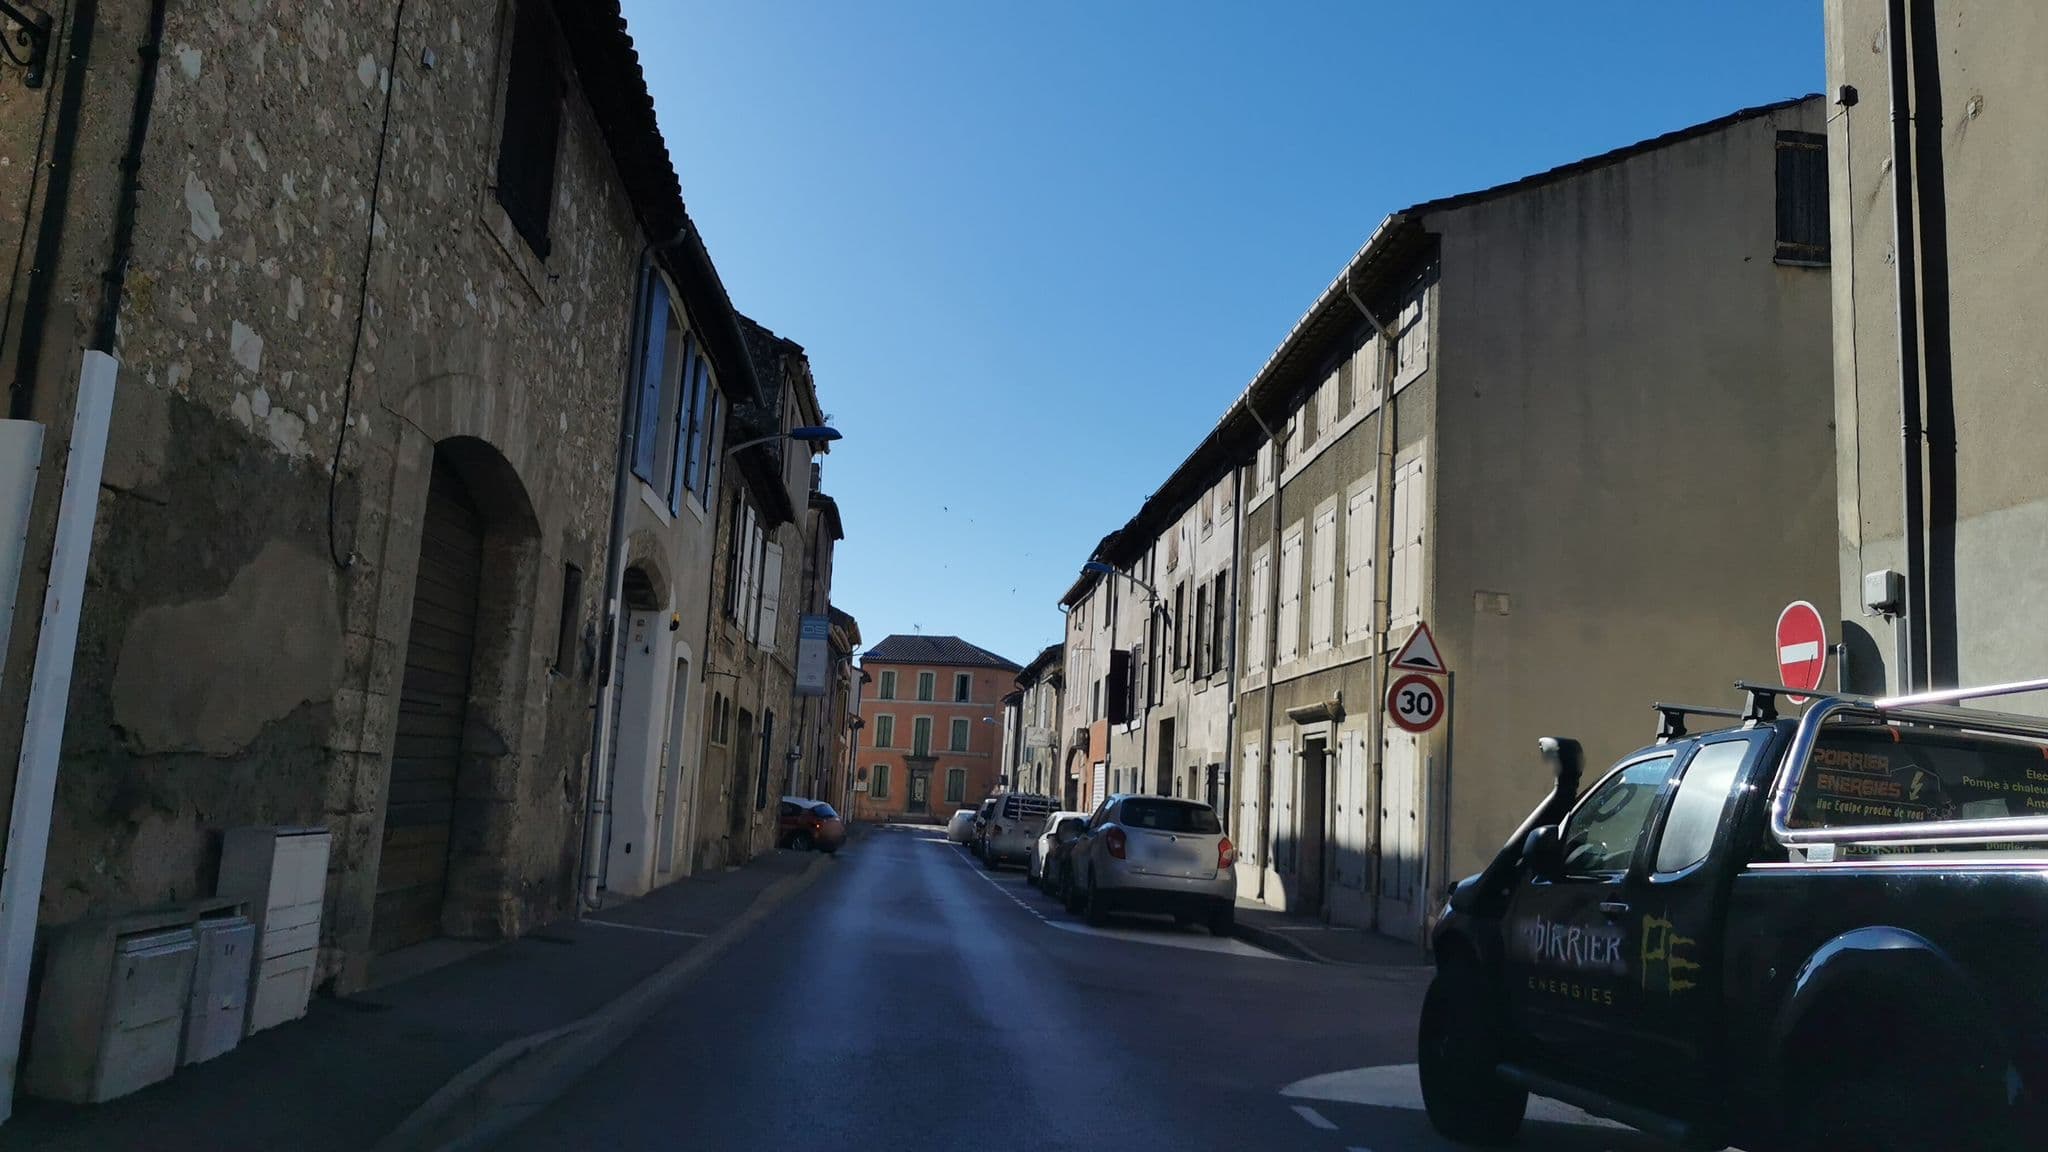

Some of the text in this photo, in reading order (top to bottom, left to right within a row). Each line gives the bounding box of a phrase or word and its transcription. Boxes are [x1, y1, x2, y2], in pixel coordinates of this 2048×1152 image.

[1400, 690, 1433, 716] 30
[1814, 748, 1889, 773] POIRRIER
[1962, 776, 2000, 790] Pompe
[2003, 781, 2009, 790] à
[1816, 798, 1831, 810] Une
[1863, 804, 1892, 817] proche
[1894, 807, 1904, 818] de
[1528, 976, 1613, 1005] ENERGIES
